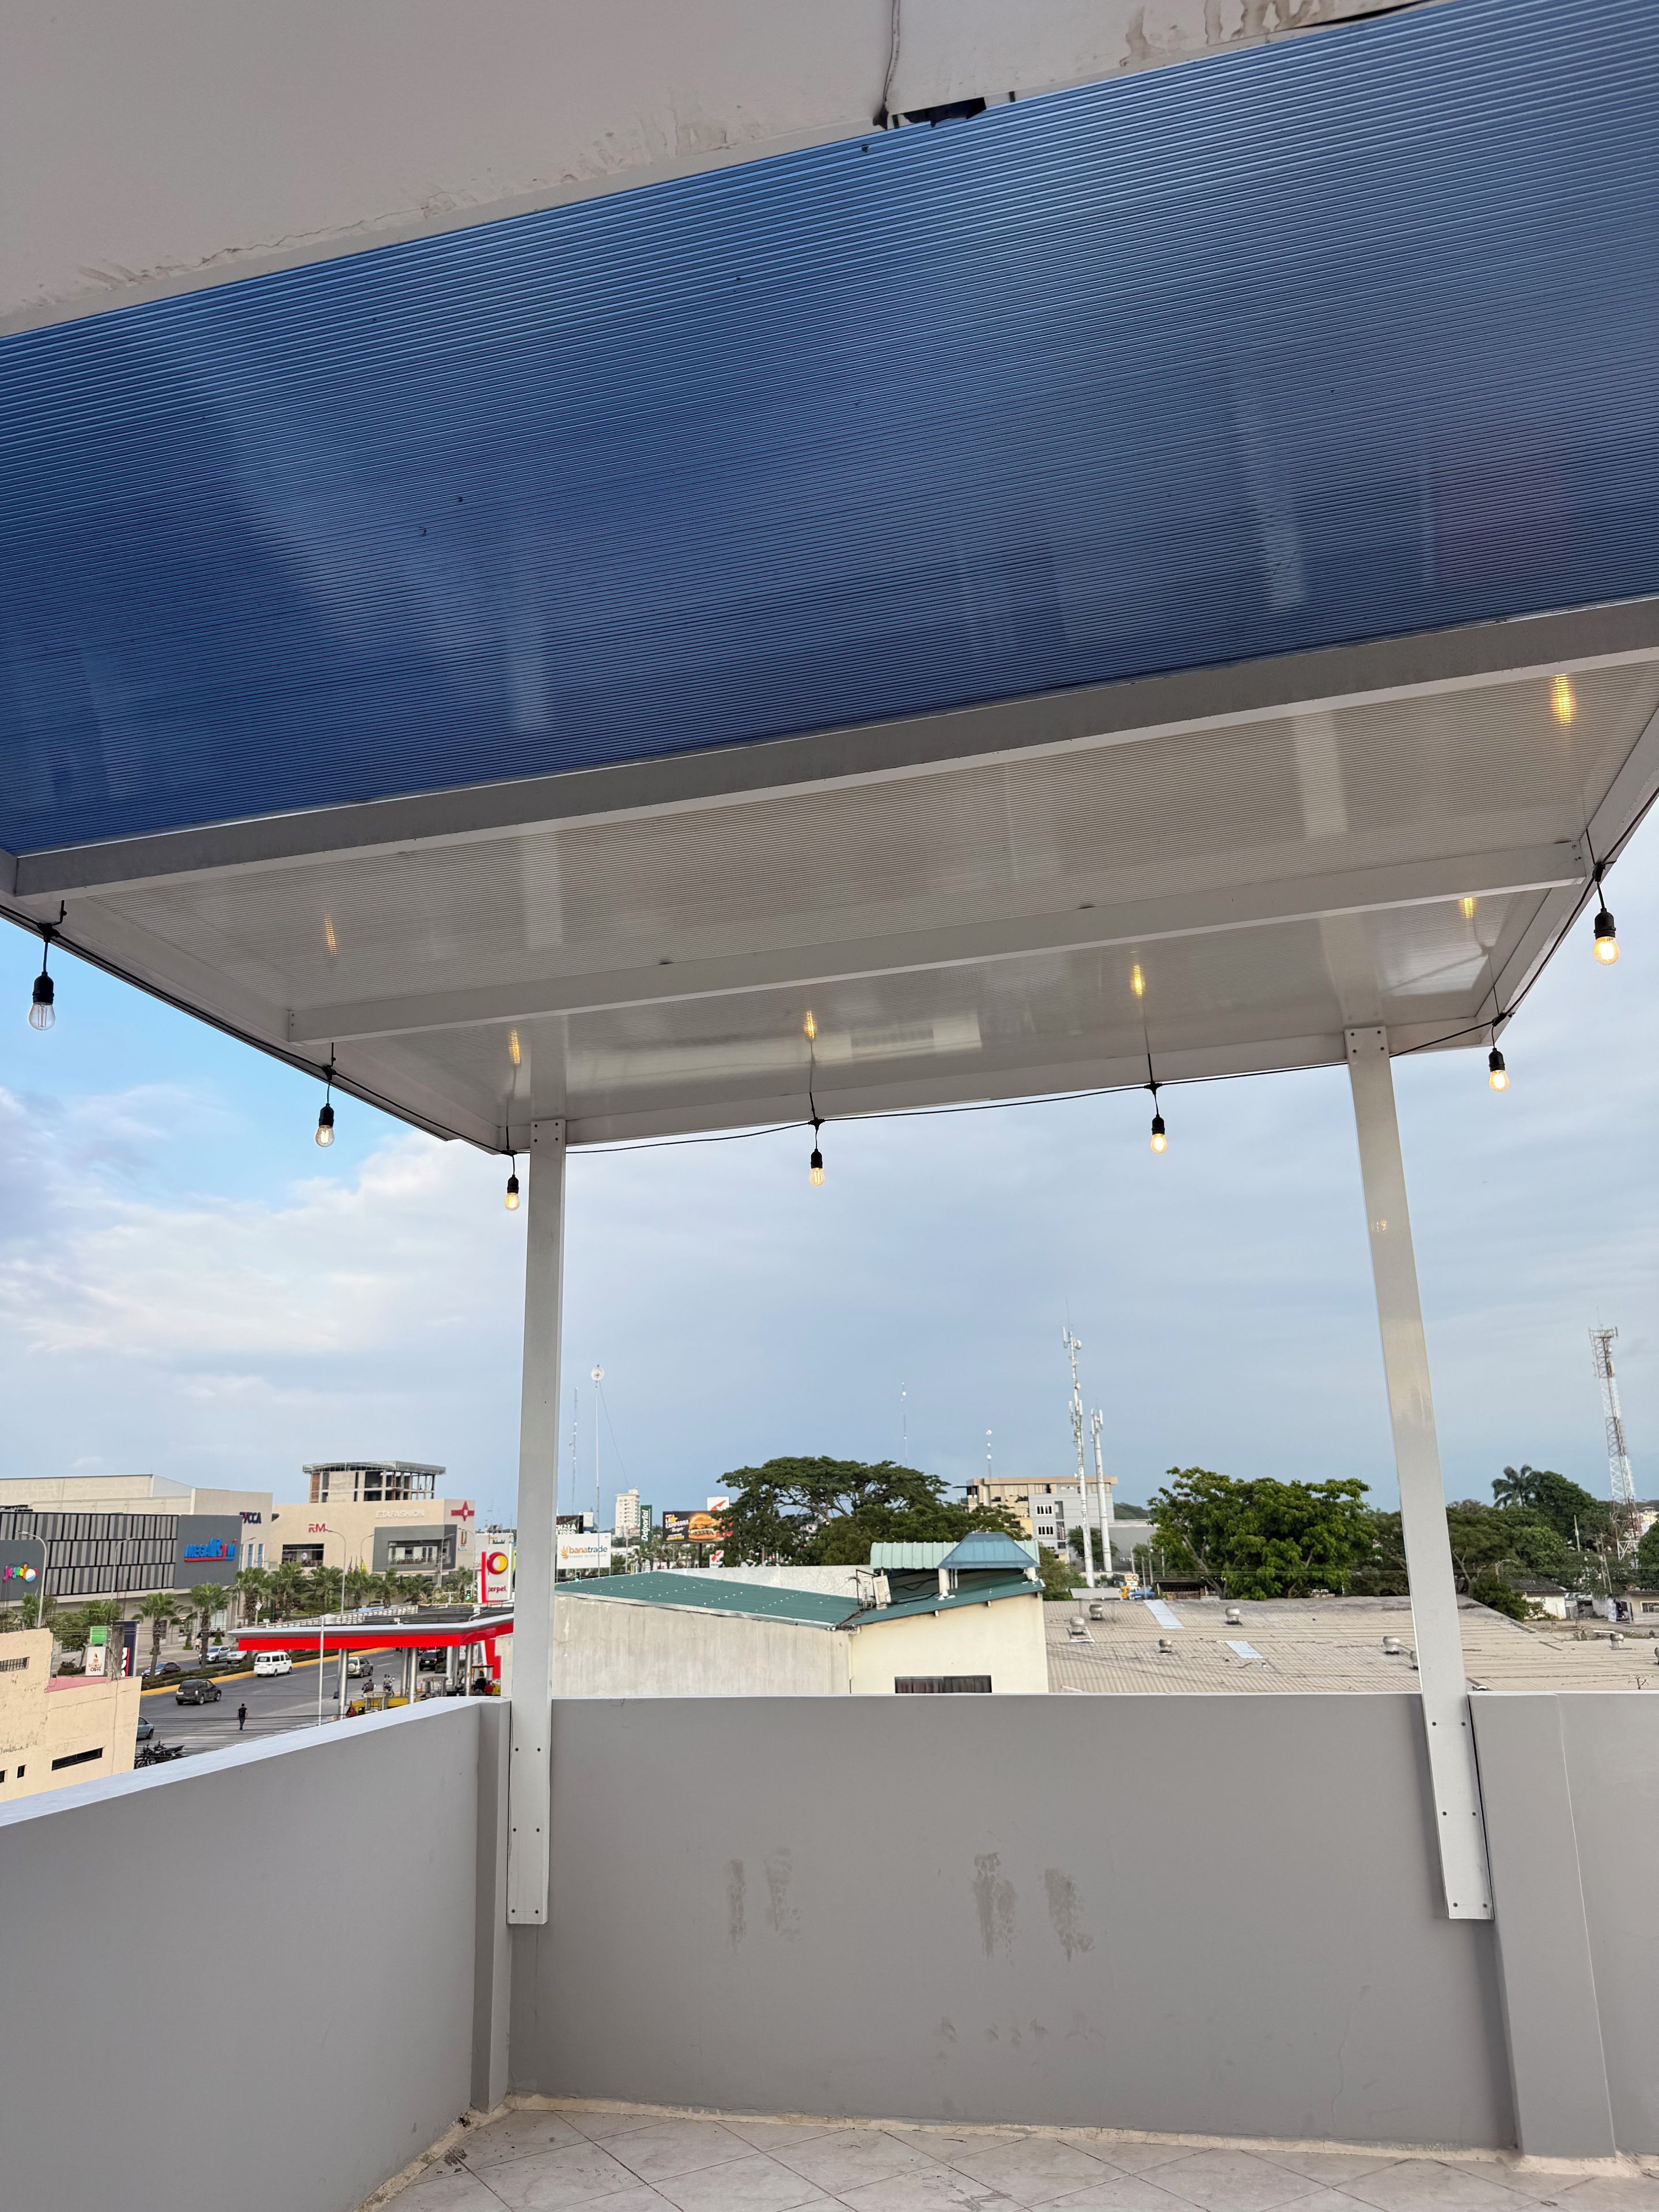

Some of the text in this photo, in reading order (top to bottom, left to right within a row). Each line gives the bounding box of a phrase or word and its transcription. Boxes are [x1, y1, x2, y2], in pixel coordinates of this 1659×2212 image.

[376, 1510, 425, 1518] ETAFASHION
[308, 1523, 326, 1532] RM
[641, 1510, 650, 1541] Delportal
